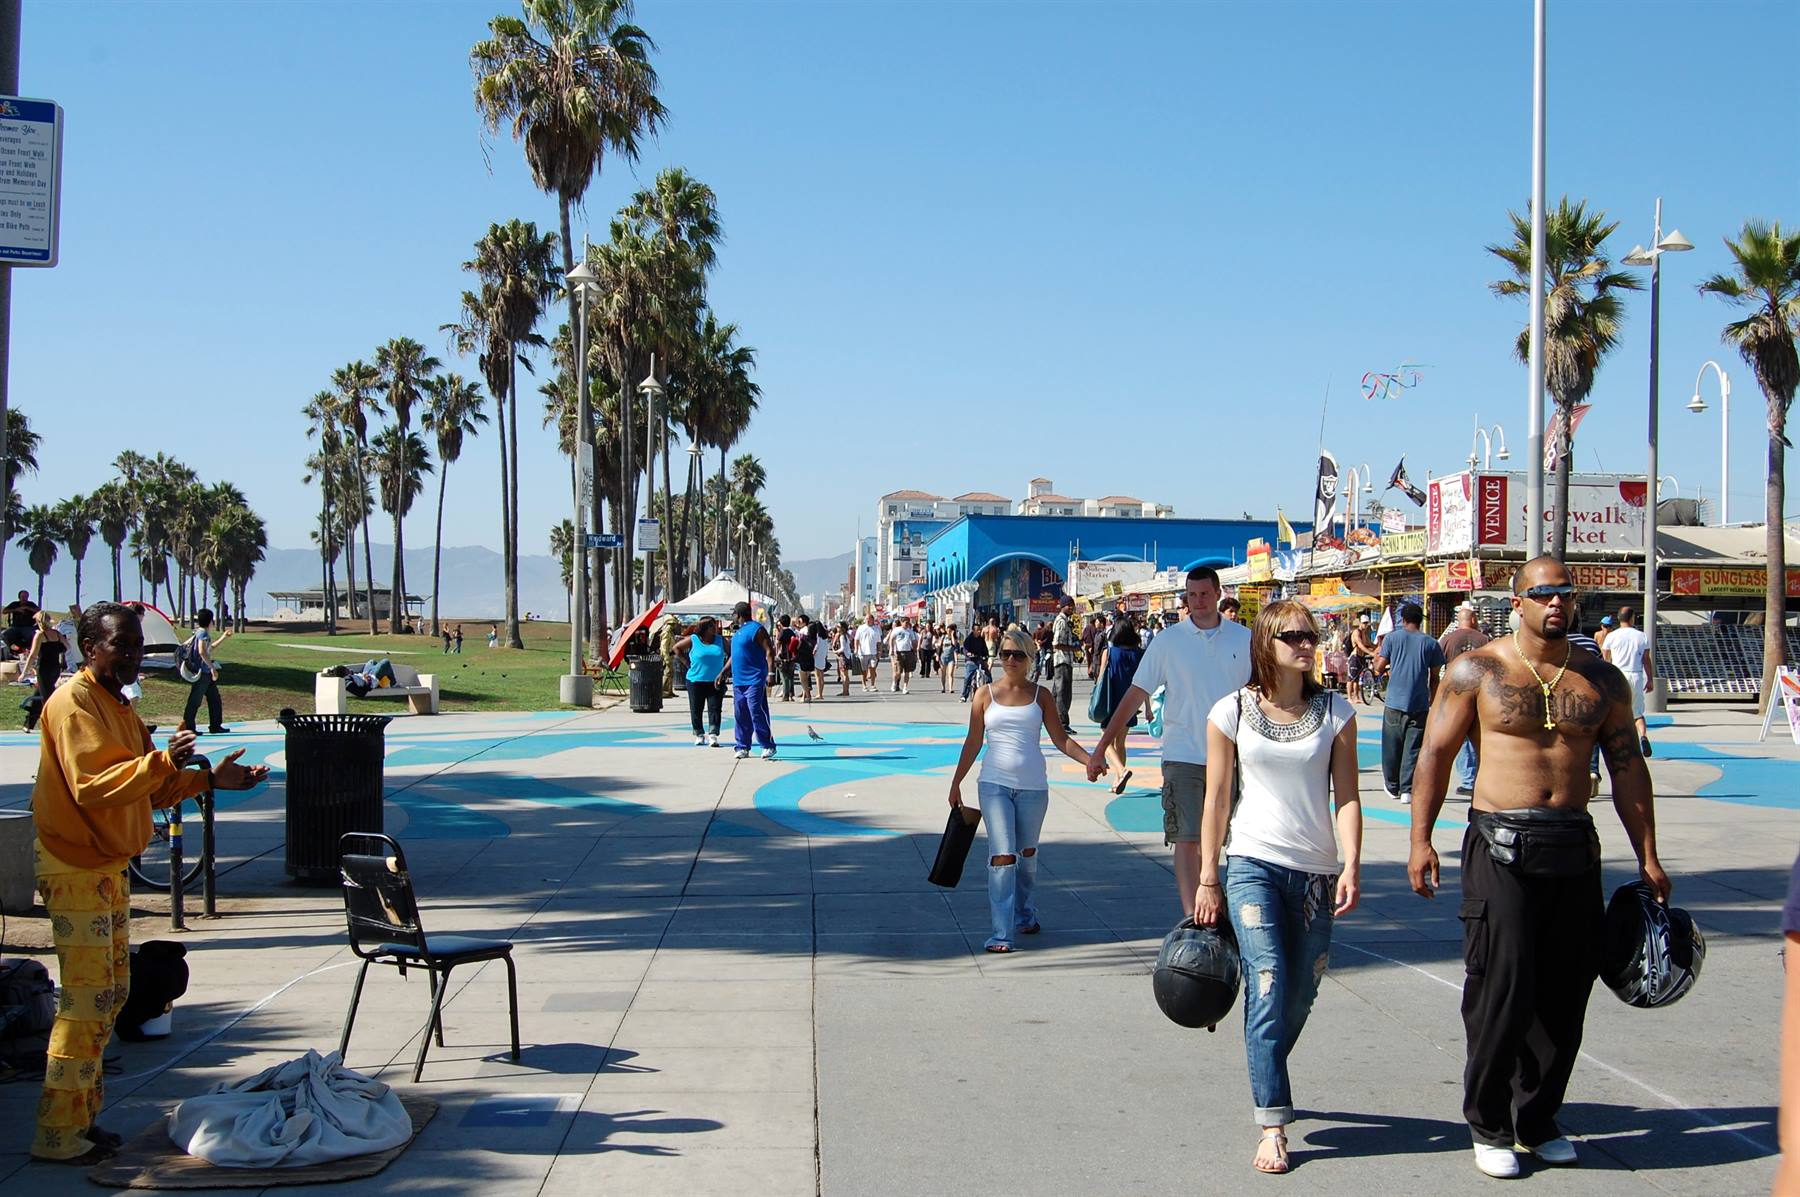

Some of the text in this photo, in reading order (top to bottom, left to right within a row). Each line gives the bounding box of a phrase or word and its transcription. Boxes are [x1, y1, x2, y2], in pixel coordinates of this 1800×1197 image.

[0, 137, 21, 145] everages
[1485, 480, 1501, 540] VENICE
[1401, 533, 1424, 552] TATTOOS
[1703, 570, 1767, 587] SUNGLASS
